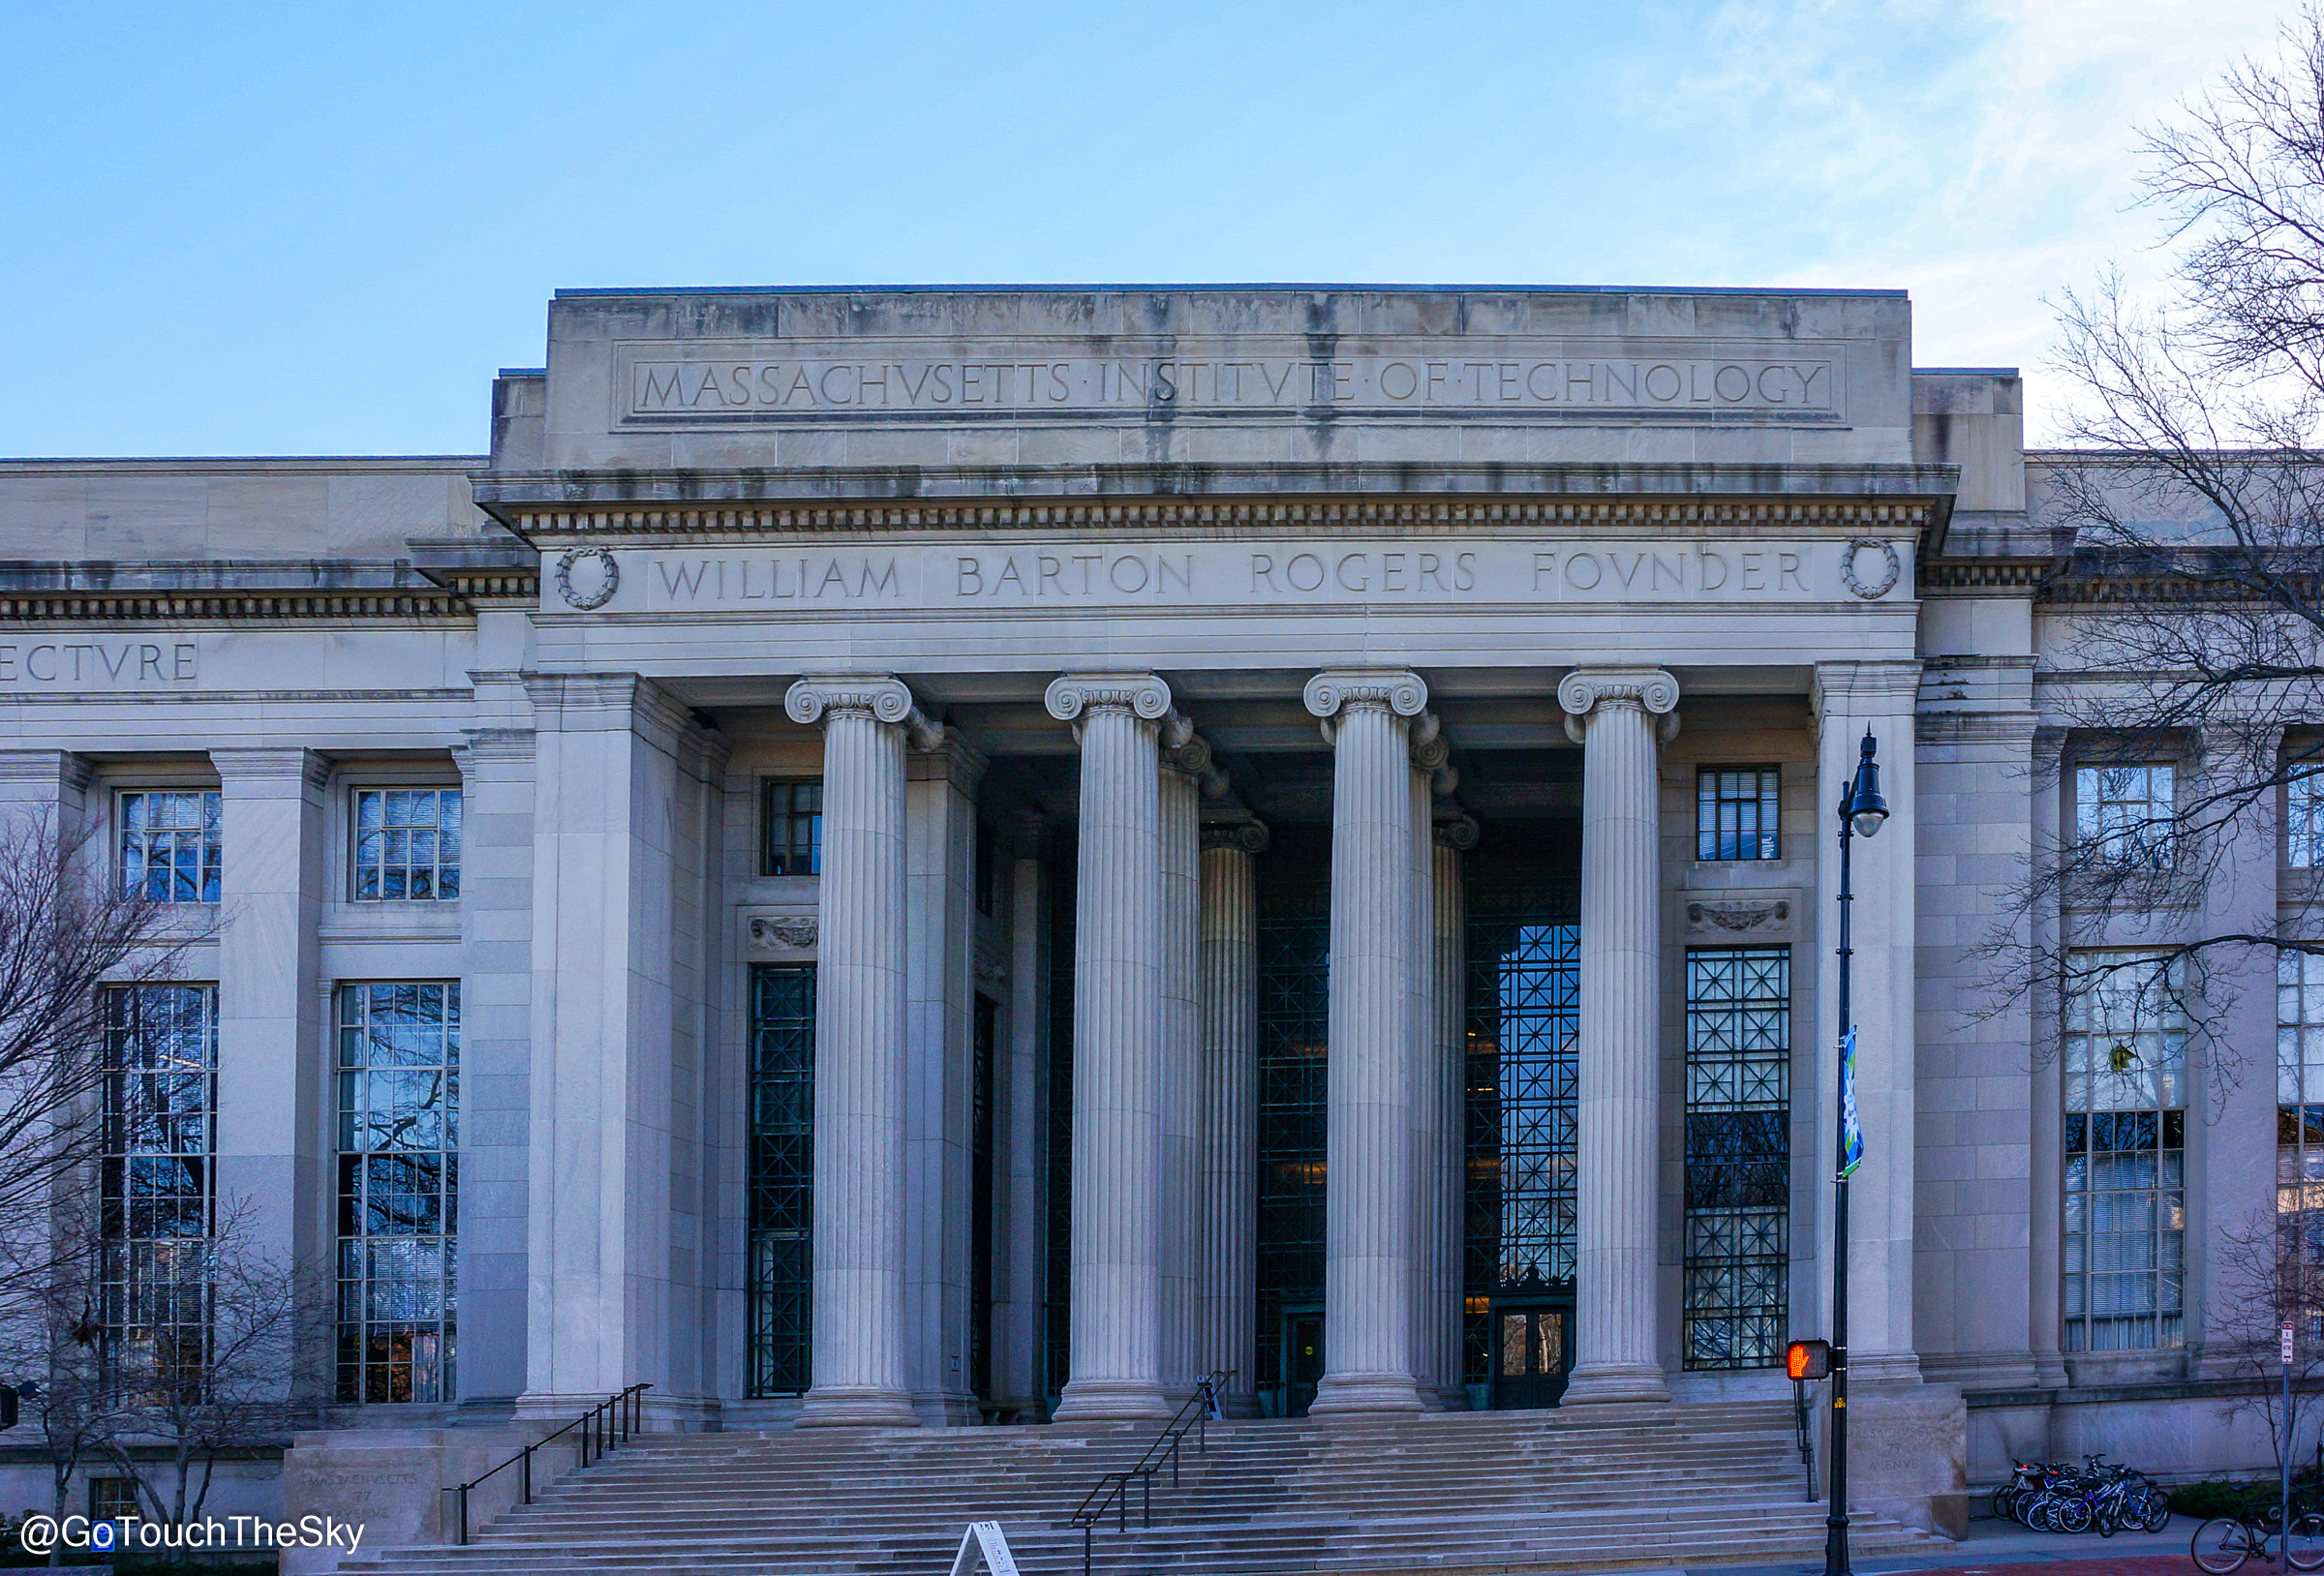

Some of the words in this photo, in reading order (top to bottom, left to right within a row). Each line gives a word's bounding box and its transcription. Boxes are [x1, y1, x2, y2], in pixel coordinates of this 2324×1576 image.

[641, 362, 1071, 408] MASSACHVSETTS
[1098, 362, 1355, 403] INSTITVTE
[1380, 361, 1448, 402] OF
[1463, 361, 1824, 404] TECHNOLOGY
[654, 557, 903, 600] WILLIAM
[956, 555, 1193, 595] BARTON
[1251, 553, 1477, 592] ROGERS
[1532, 553, 1810, 592] FOVNDER
[0, 644, 197, 682] ECTVRE
